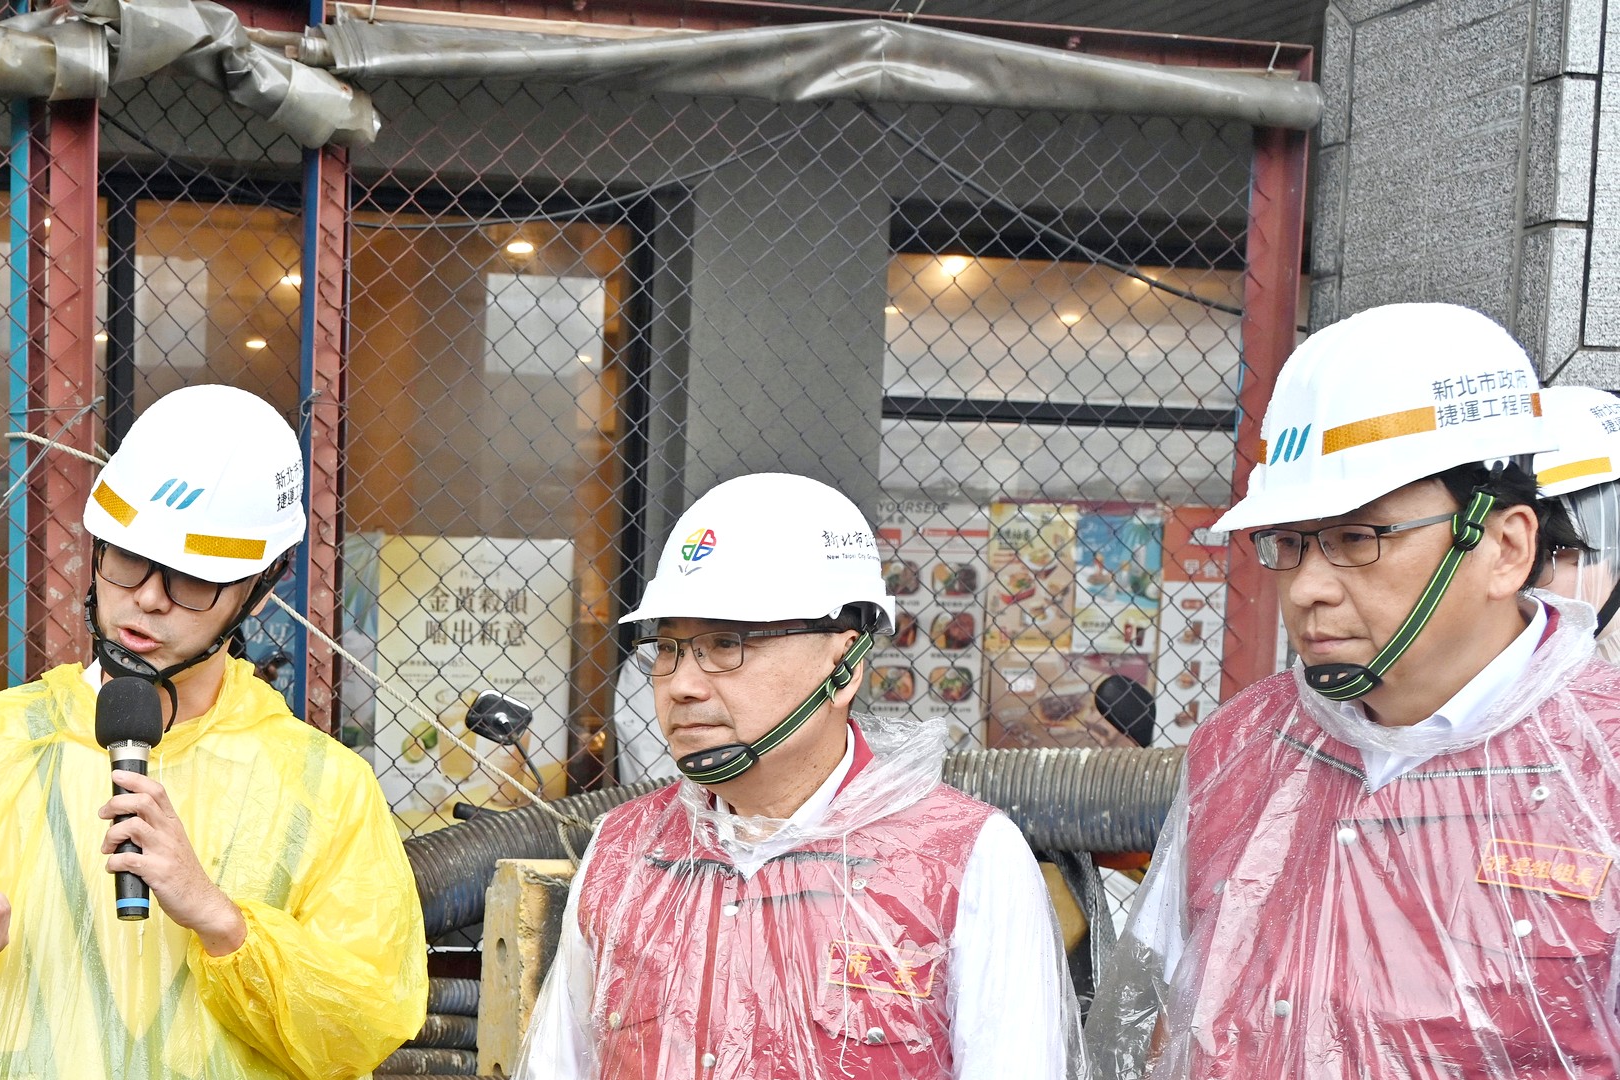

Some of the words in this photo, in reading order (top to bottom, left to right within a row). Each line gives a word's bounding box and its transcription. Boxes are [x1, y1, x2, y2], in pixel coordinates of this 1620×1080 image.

[1432, 369, 1528, 401] 新北市政府
[1437, 393, 1533, 428] 捷運工程局
[275, 459, 303, 490] 新北市
[277, 482, 303, 512] 捷運工
